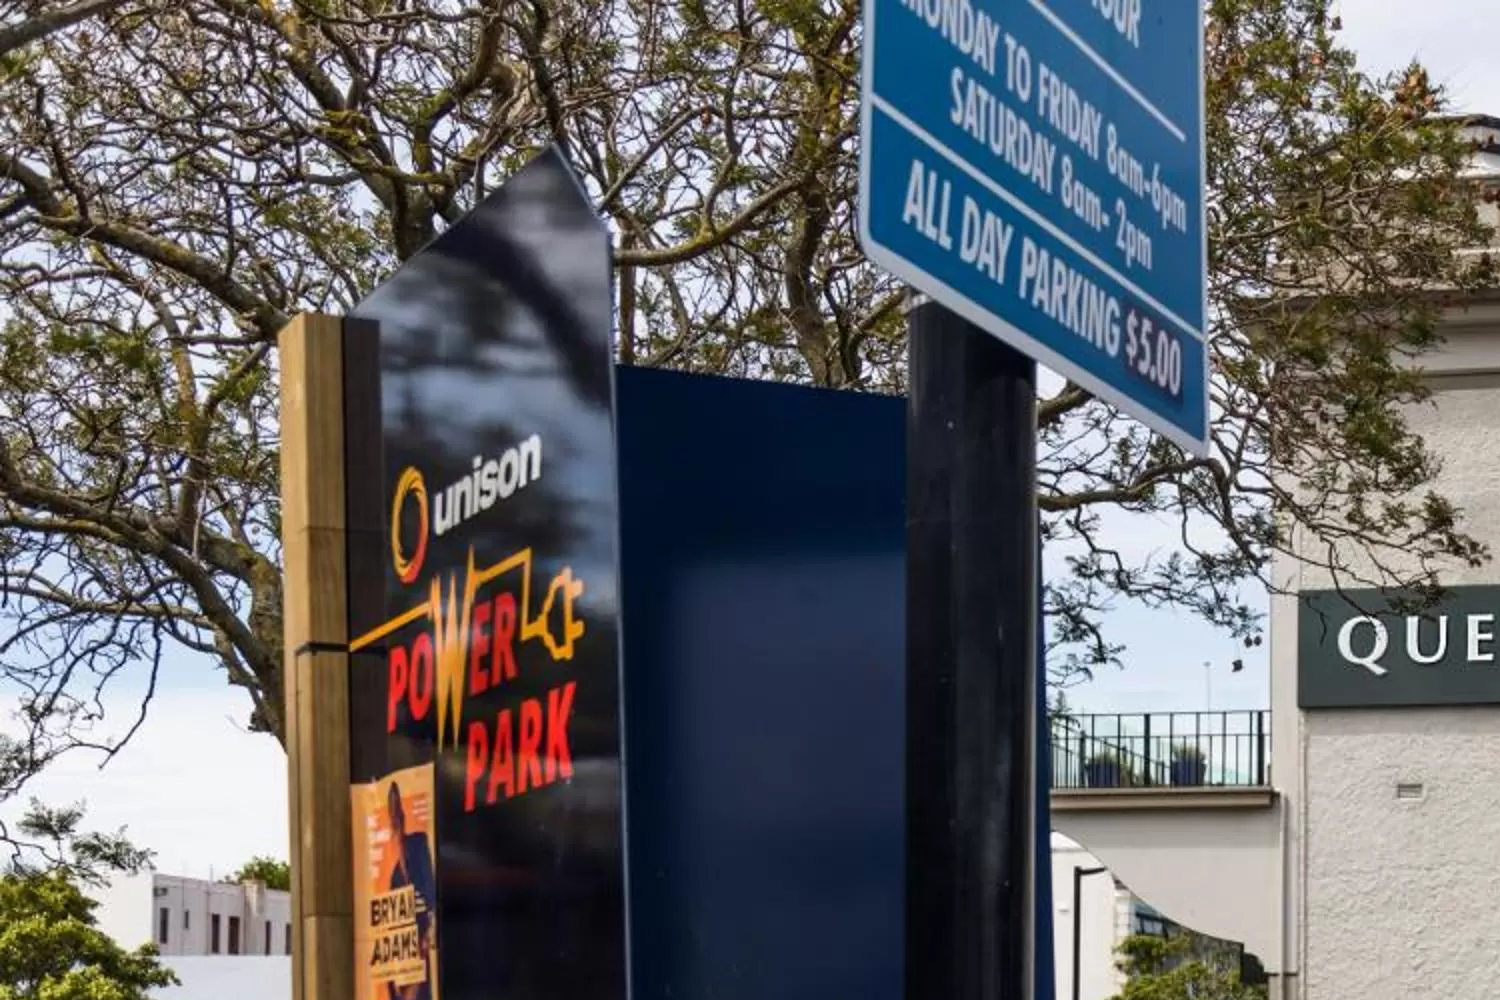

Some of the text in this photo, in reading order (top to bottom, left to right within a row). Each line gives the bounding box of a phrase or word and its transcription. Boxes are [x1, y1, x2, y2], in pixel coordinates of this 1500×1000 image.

[902, 0, 1187, 234] ONDAY TO FRIDAY 8am-6pm
[950, 66, 1056, 194] SATURDAY
[1115, 200, 1152, 271] 2pm
[903, 160, 1182, 396] ALL DAY PARKING $5.00
[433, 433, 542, 536] unison
[387, 544, 519, 753] POWER
[464, 682, 577, 812] PARK
[370, 933, 421, 966] ADAMS
